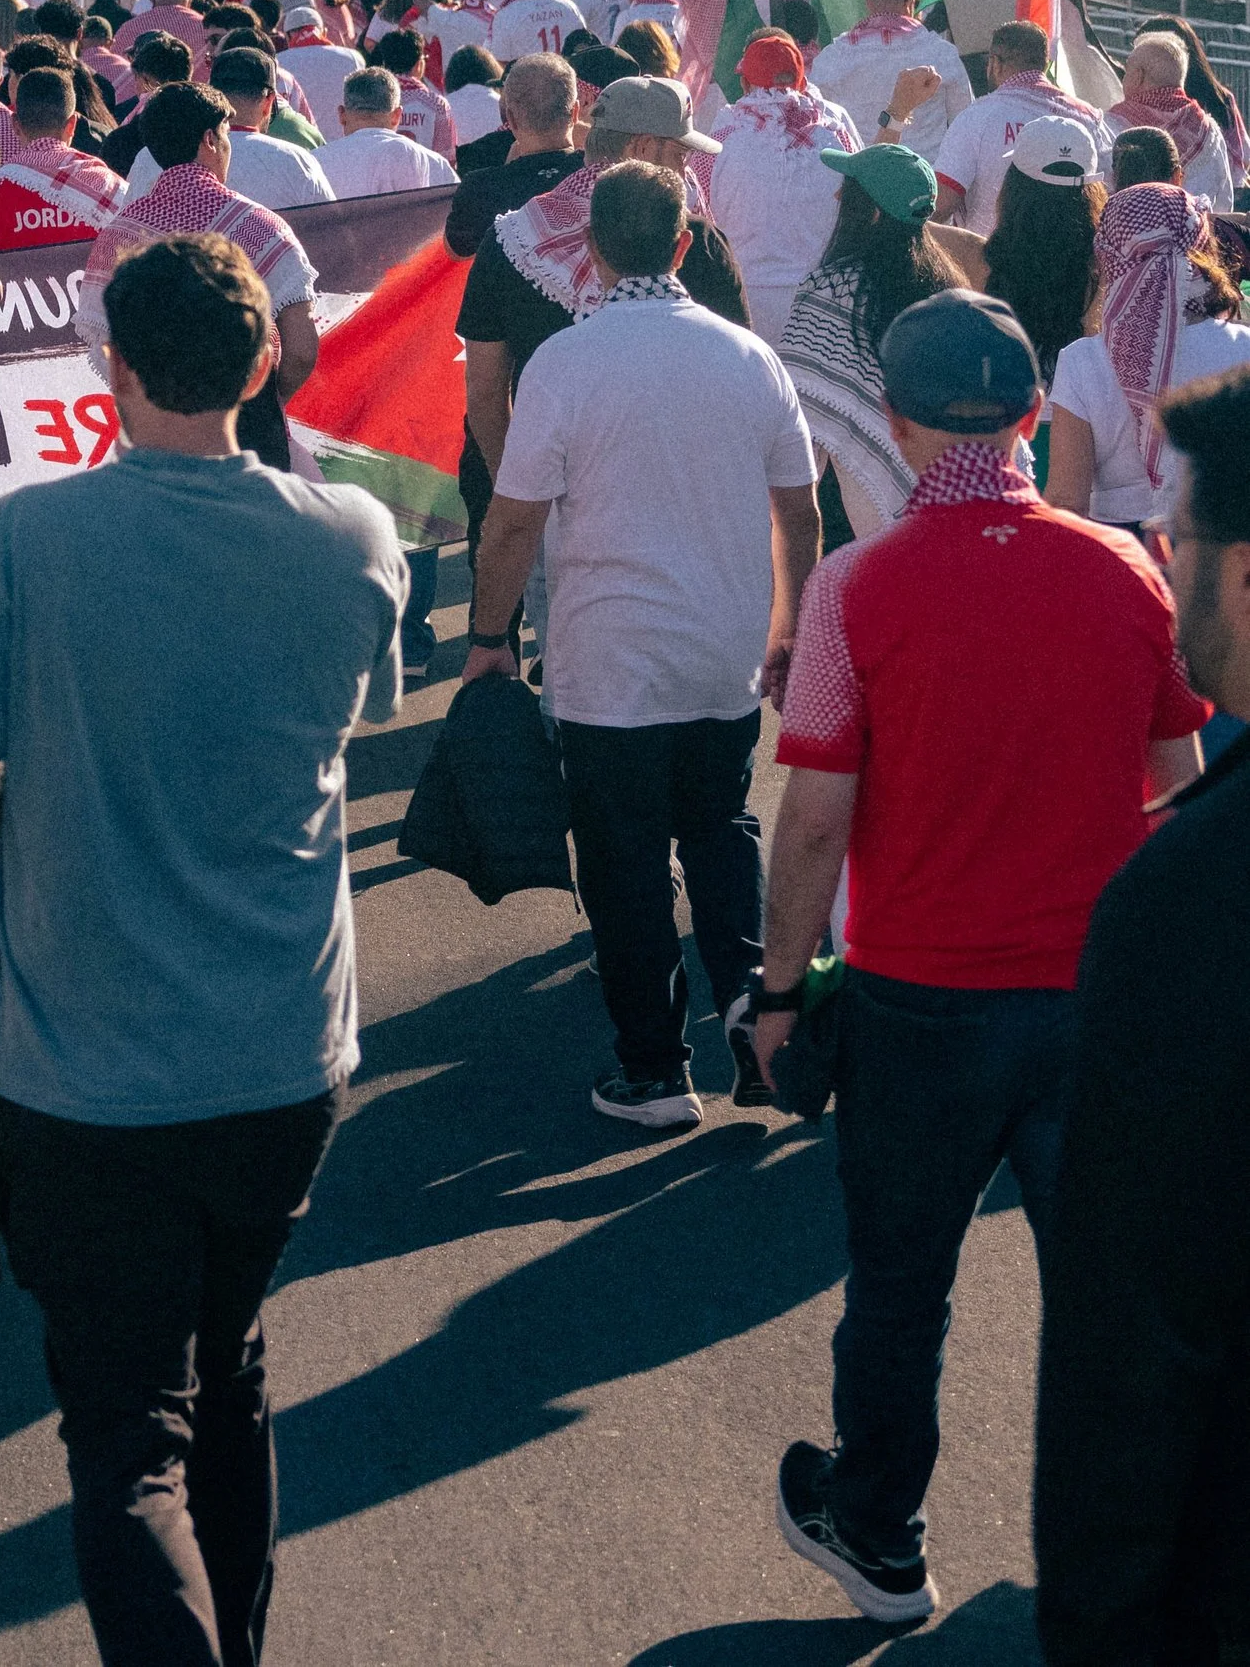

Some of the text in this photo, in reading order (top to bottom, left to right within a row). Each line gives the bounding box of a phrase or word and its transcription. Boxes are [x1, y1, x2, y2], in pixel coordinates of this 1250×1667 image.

[530, 9, 563, 22] YAZAN
[537, 25, 561, 54] 11
[13, 208, 92, 233] JORDA
